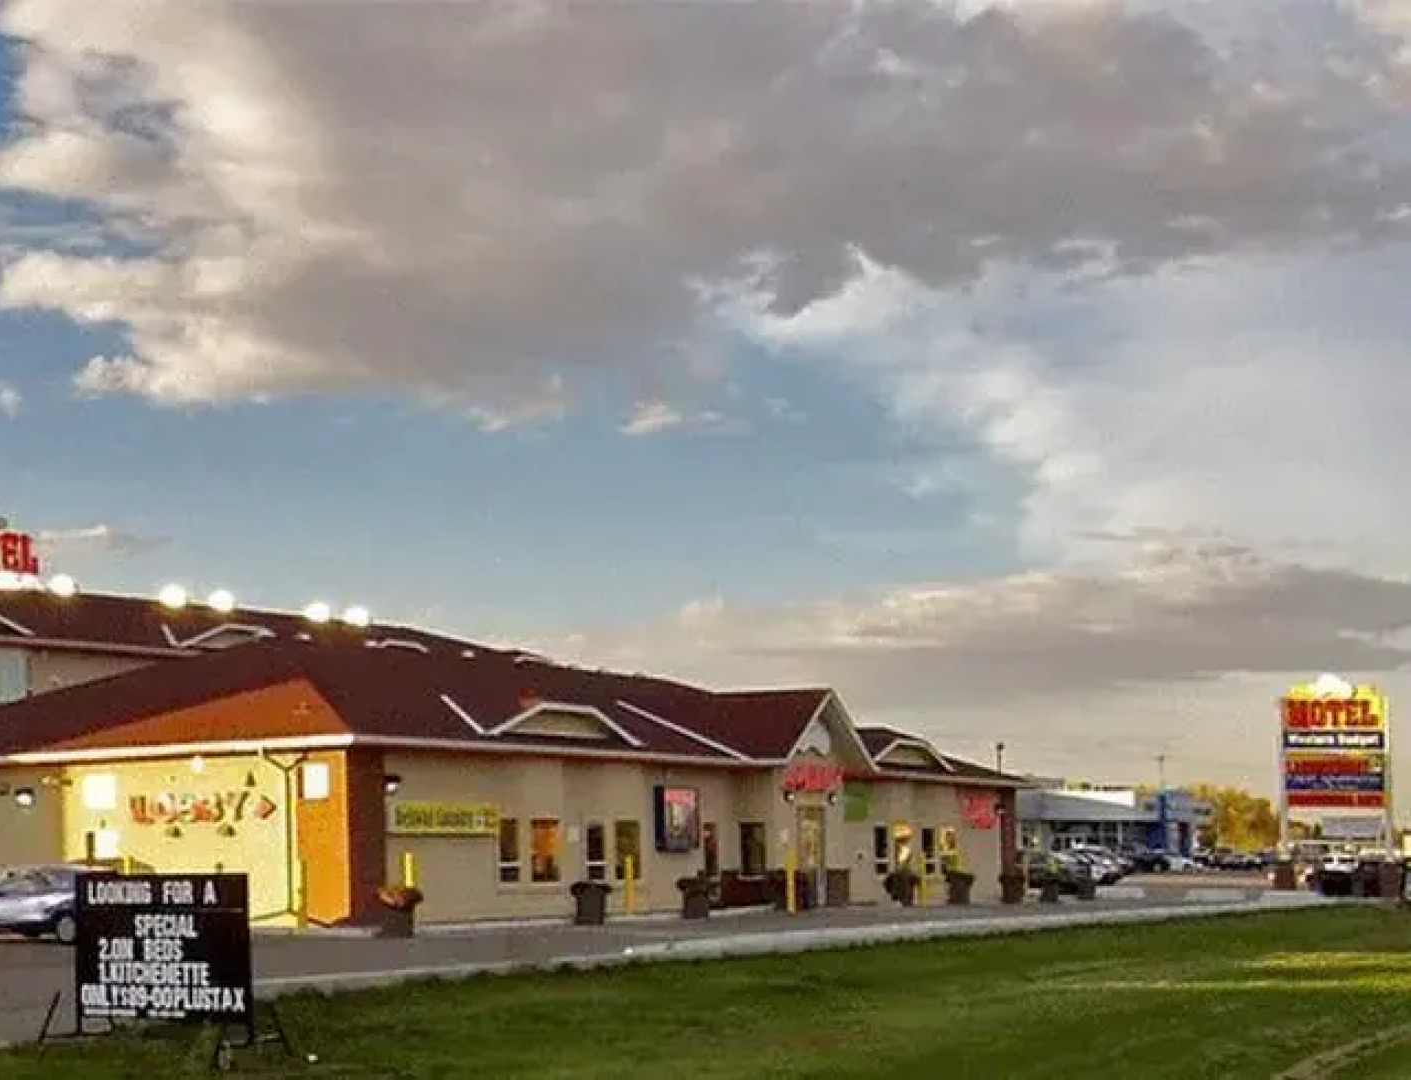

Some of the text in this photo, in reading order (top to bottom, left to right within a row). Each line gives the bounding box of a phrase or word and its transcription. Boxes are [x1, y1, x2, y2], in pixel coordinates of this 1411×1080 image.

[1286, 699, 1379, 726] MOTEL
[88, 880, 218, 904] LOOKING FOR A
[135, 915, 199, 938] SPECIAL
[144, 938, 183, 960] BEDS
